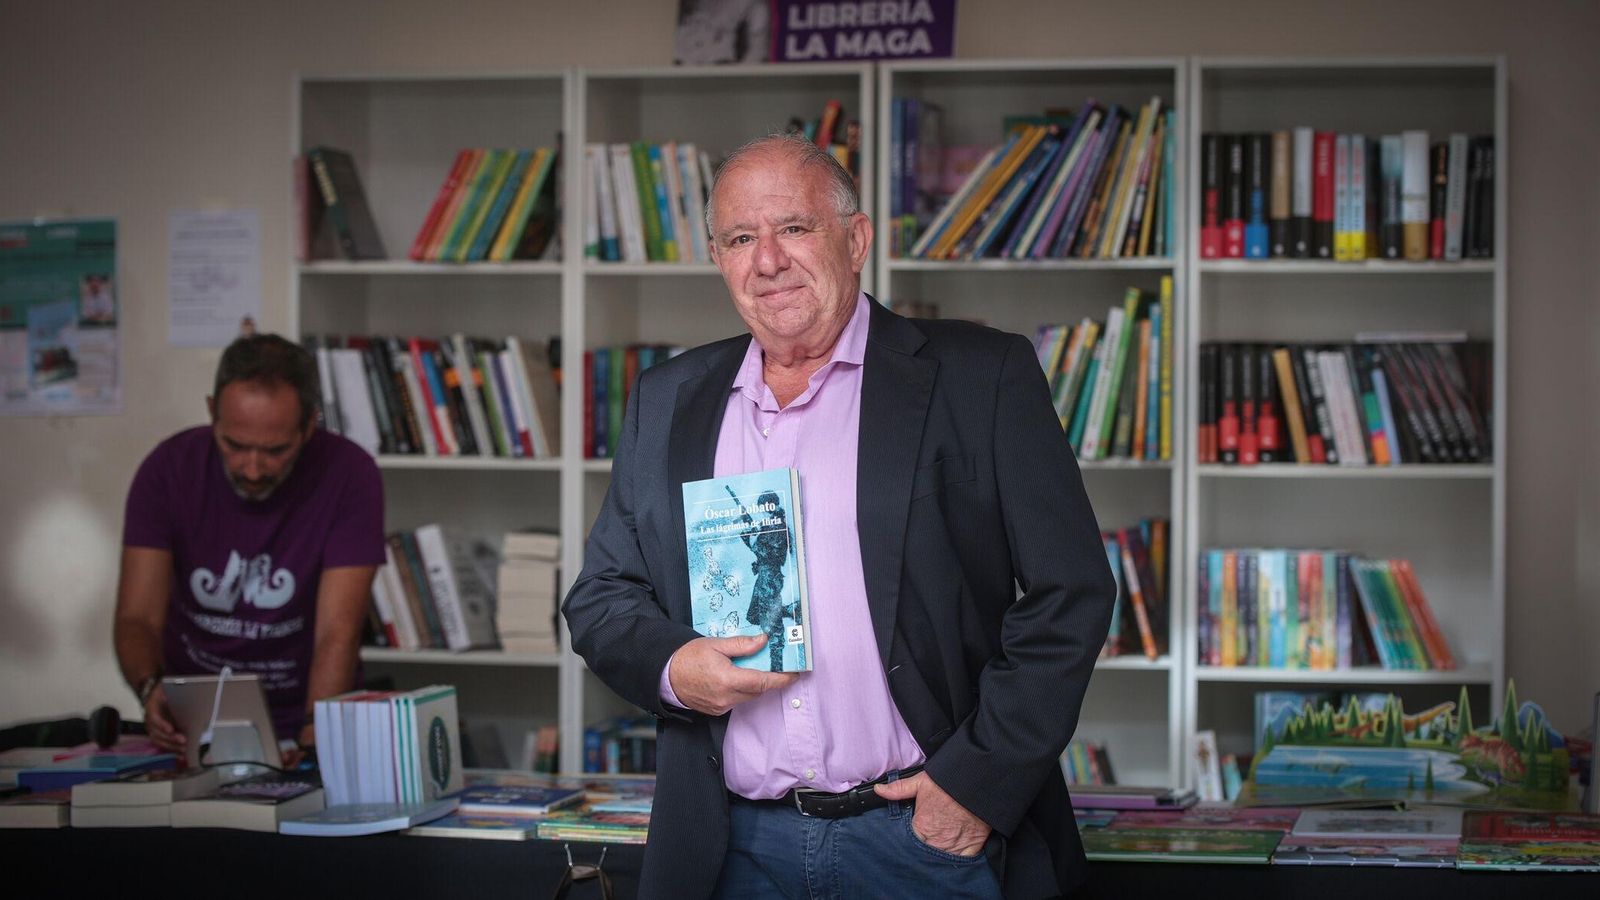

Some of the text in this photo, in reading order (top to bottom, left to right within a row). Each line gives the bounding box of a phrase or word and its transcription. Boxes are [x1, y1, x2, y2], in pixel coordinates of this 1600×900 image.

[785, 28, 932, 59] LA MAGA
[704, 502, 776, 519] Óscar Lobato
[701, 525, 714, 534] Las
[716, 521, 750, 533] lágrimas
[751, 519, 760, 528] de
